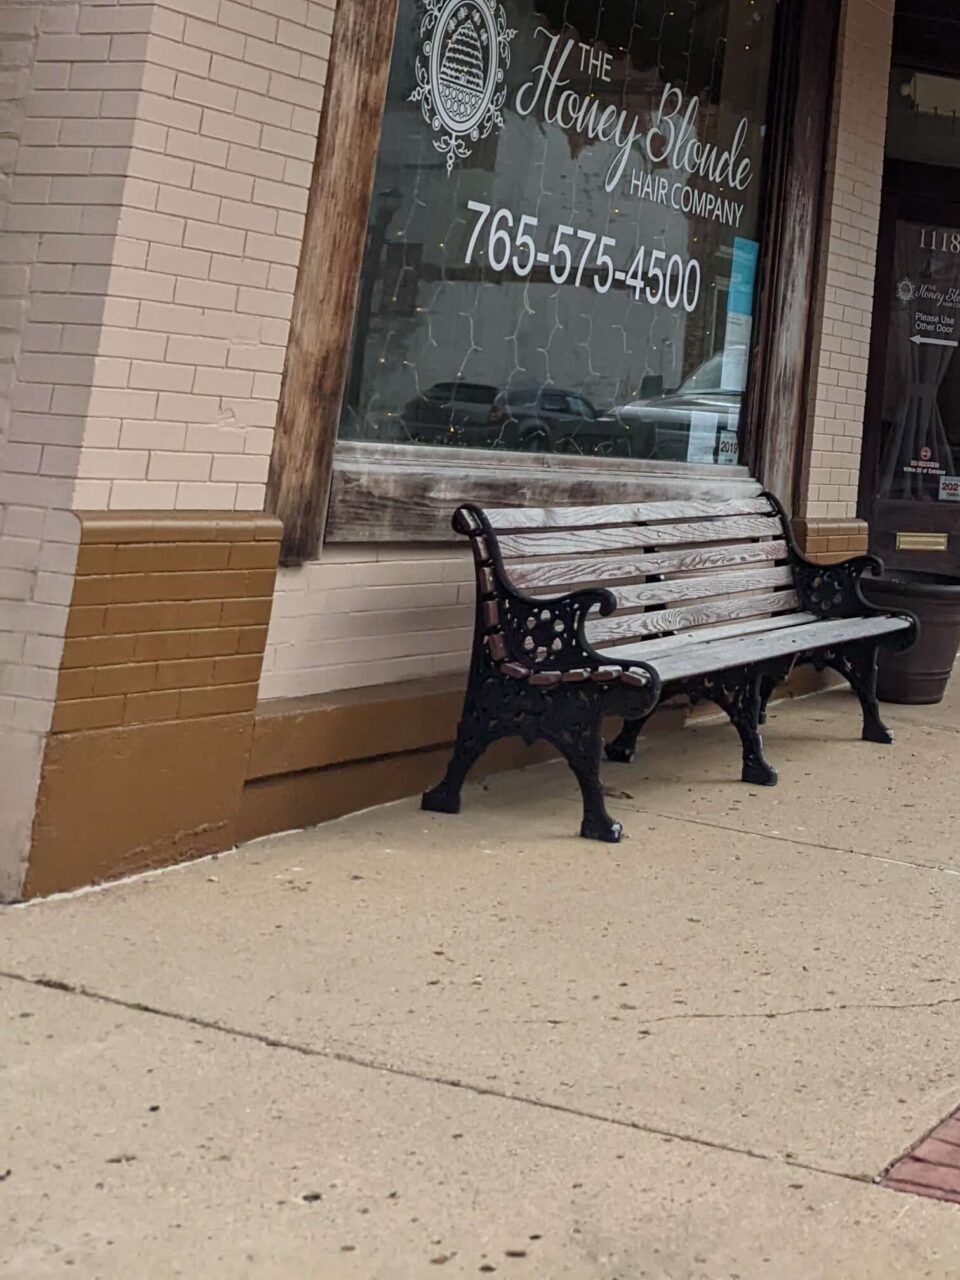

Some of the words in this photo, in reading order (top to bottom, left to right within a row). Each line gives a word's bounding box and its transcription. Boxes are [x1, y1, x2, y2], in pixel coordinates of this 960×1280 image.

[579, 42, 613, 82] THE
[515, 26, 641, 192] Honey
[645, 82, 754, 191] Blonde
[630, 169, 669, 205] HAIR
[670, 183, 744, 228] COMPANY
[464, 200, 700, 312] 765-575-4500
[920, 229, 960, 253] 1118
[915, 312, 940, 322] Please
[940, 315, 955, 325] Use
[915, 321, 935, 331] Other
[936, 324, 954, 333] Door
